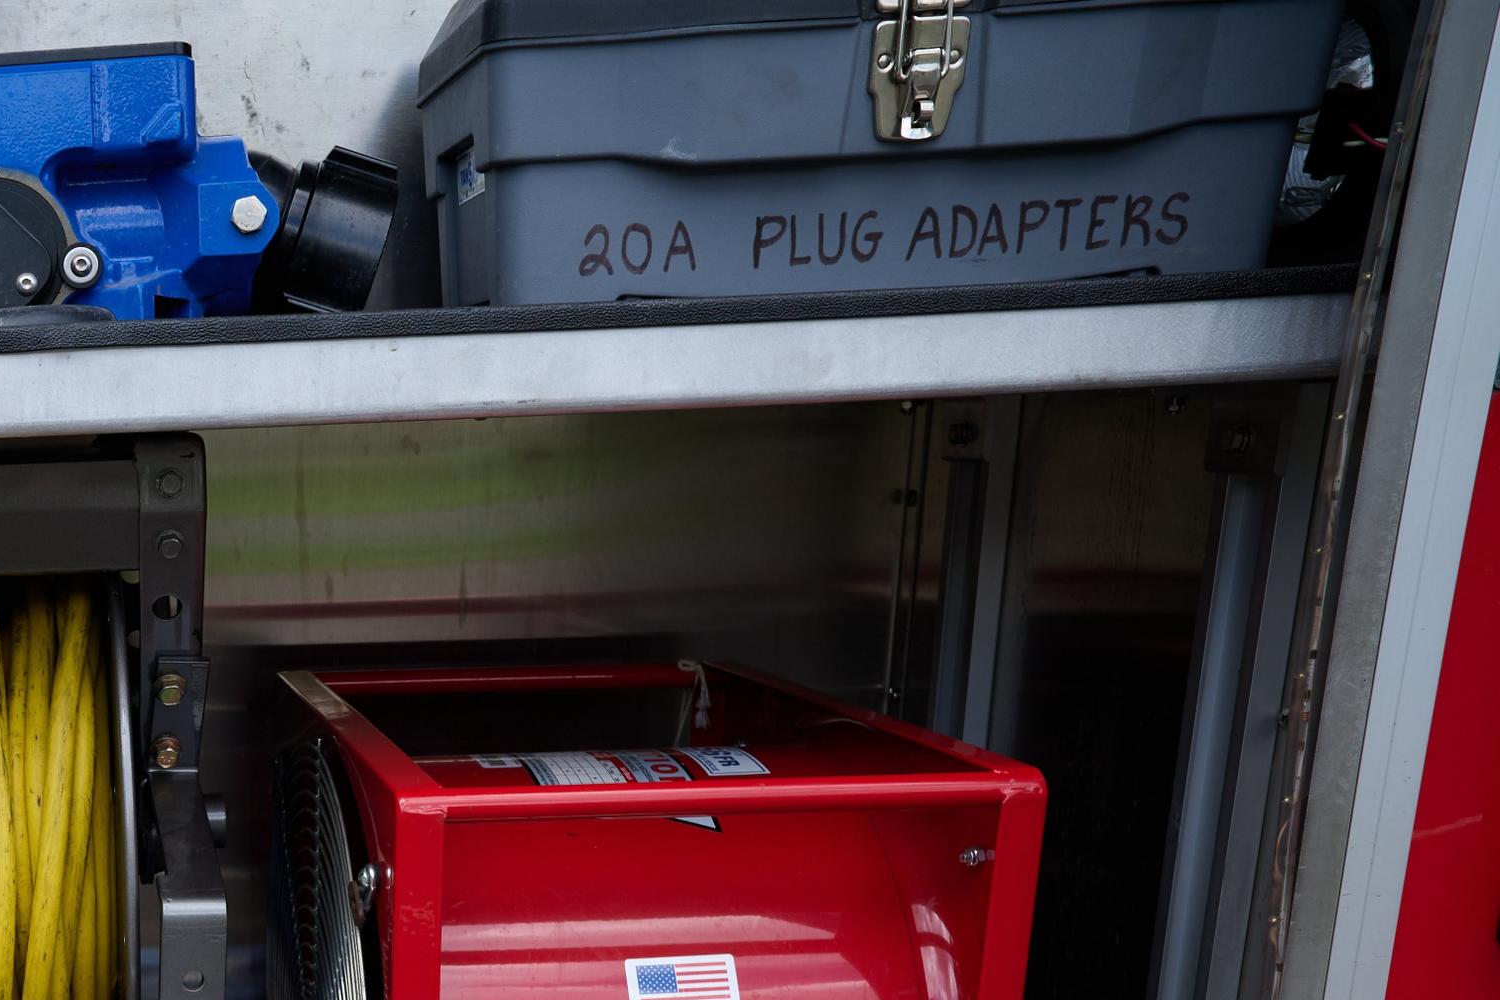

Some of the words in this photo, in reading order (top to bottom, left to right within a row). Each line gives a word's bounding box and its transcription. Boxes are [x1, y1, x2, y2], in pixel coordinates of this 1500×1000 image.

[578, 221, 698, 277] 20A
[752, 209, 884, 270] PLUG
[905, 191, 1192, 263] ADAPTERS
